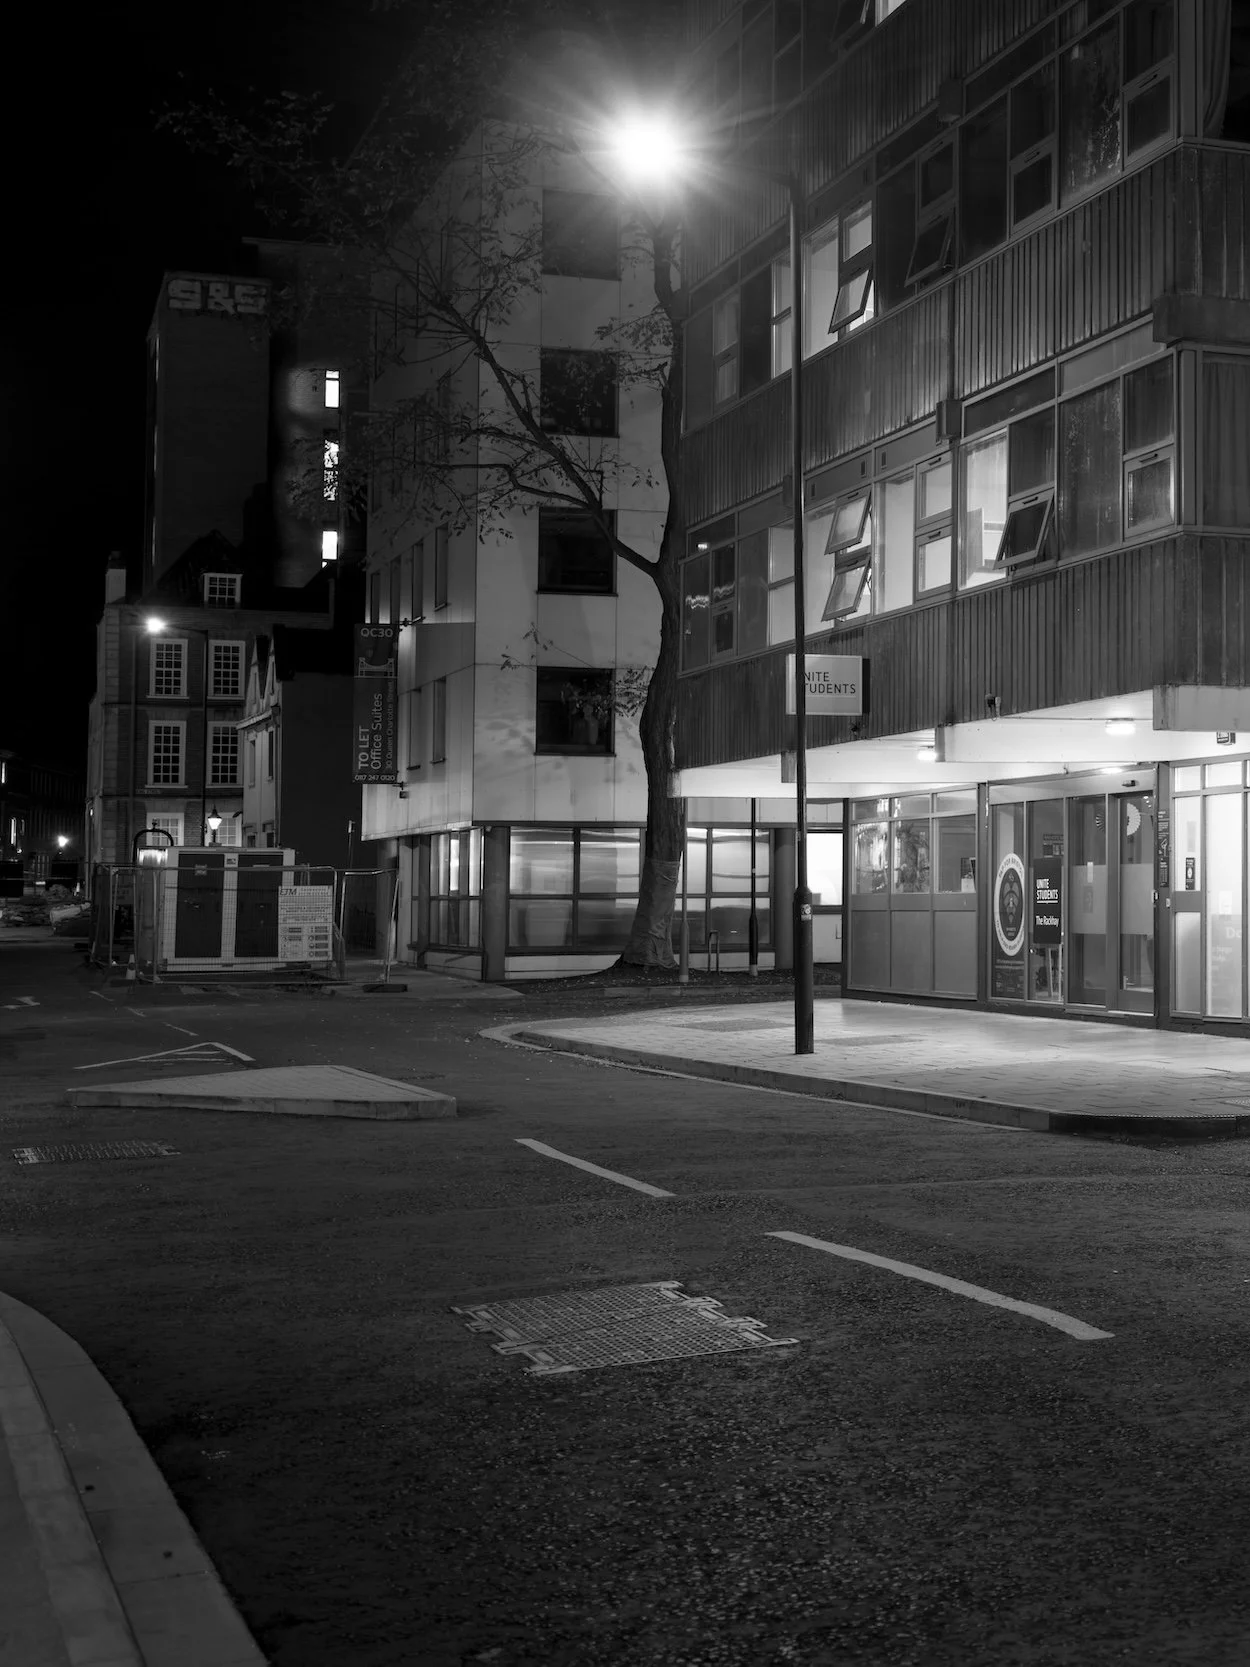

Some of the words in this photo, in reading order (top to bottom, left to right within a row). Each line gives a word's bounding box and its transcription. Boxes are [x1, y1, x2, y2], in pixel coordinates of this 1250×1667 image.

[361, 628, 393, 638] QC30
[804, 672, 830, 682] NITE
[805, 683, 856, 694] TUDENTS
[372, 693, 383, 730] Suites
[359, 725, 370, 748] LET
[371, 735, 382, 770] Office
[359, 752, 370, 769] TO
[1037, 879, 1049, 889] UNITE
[1037, 889, 1058, 900] STUDENTS
